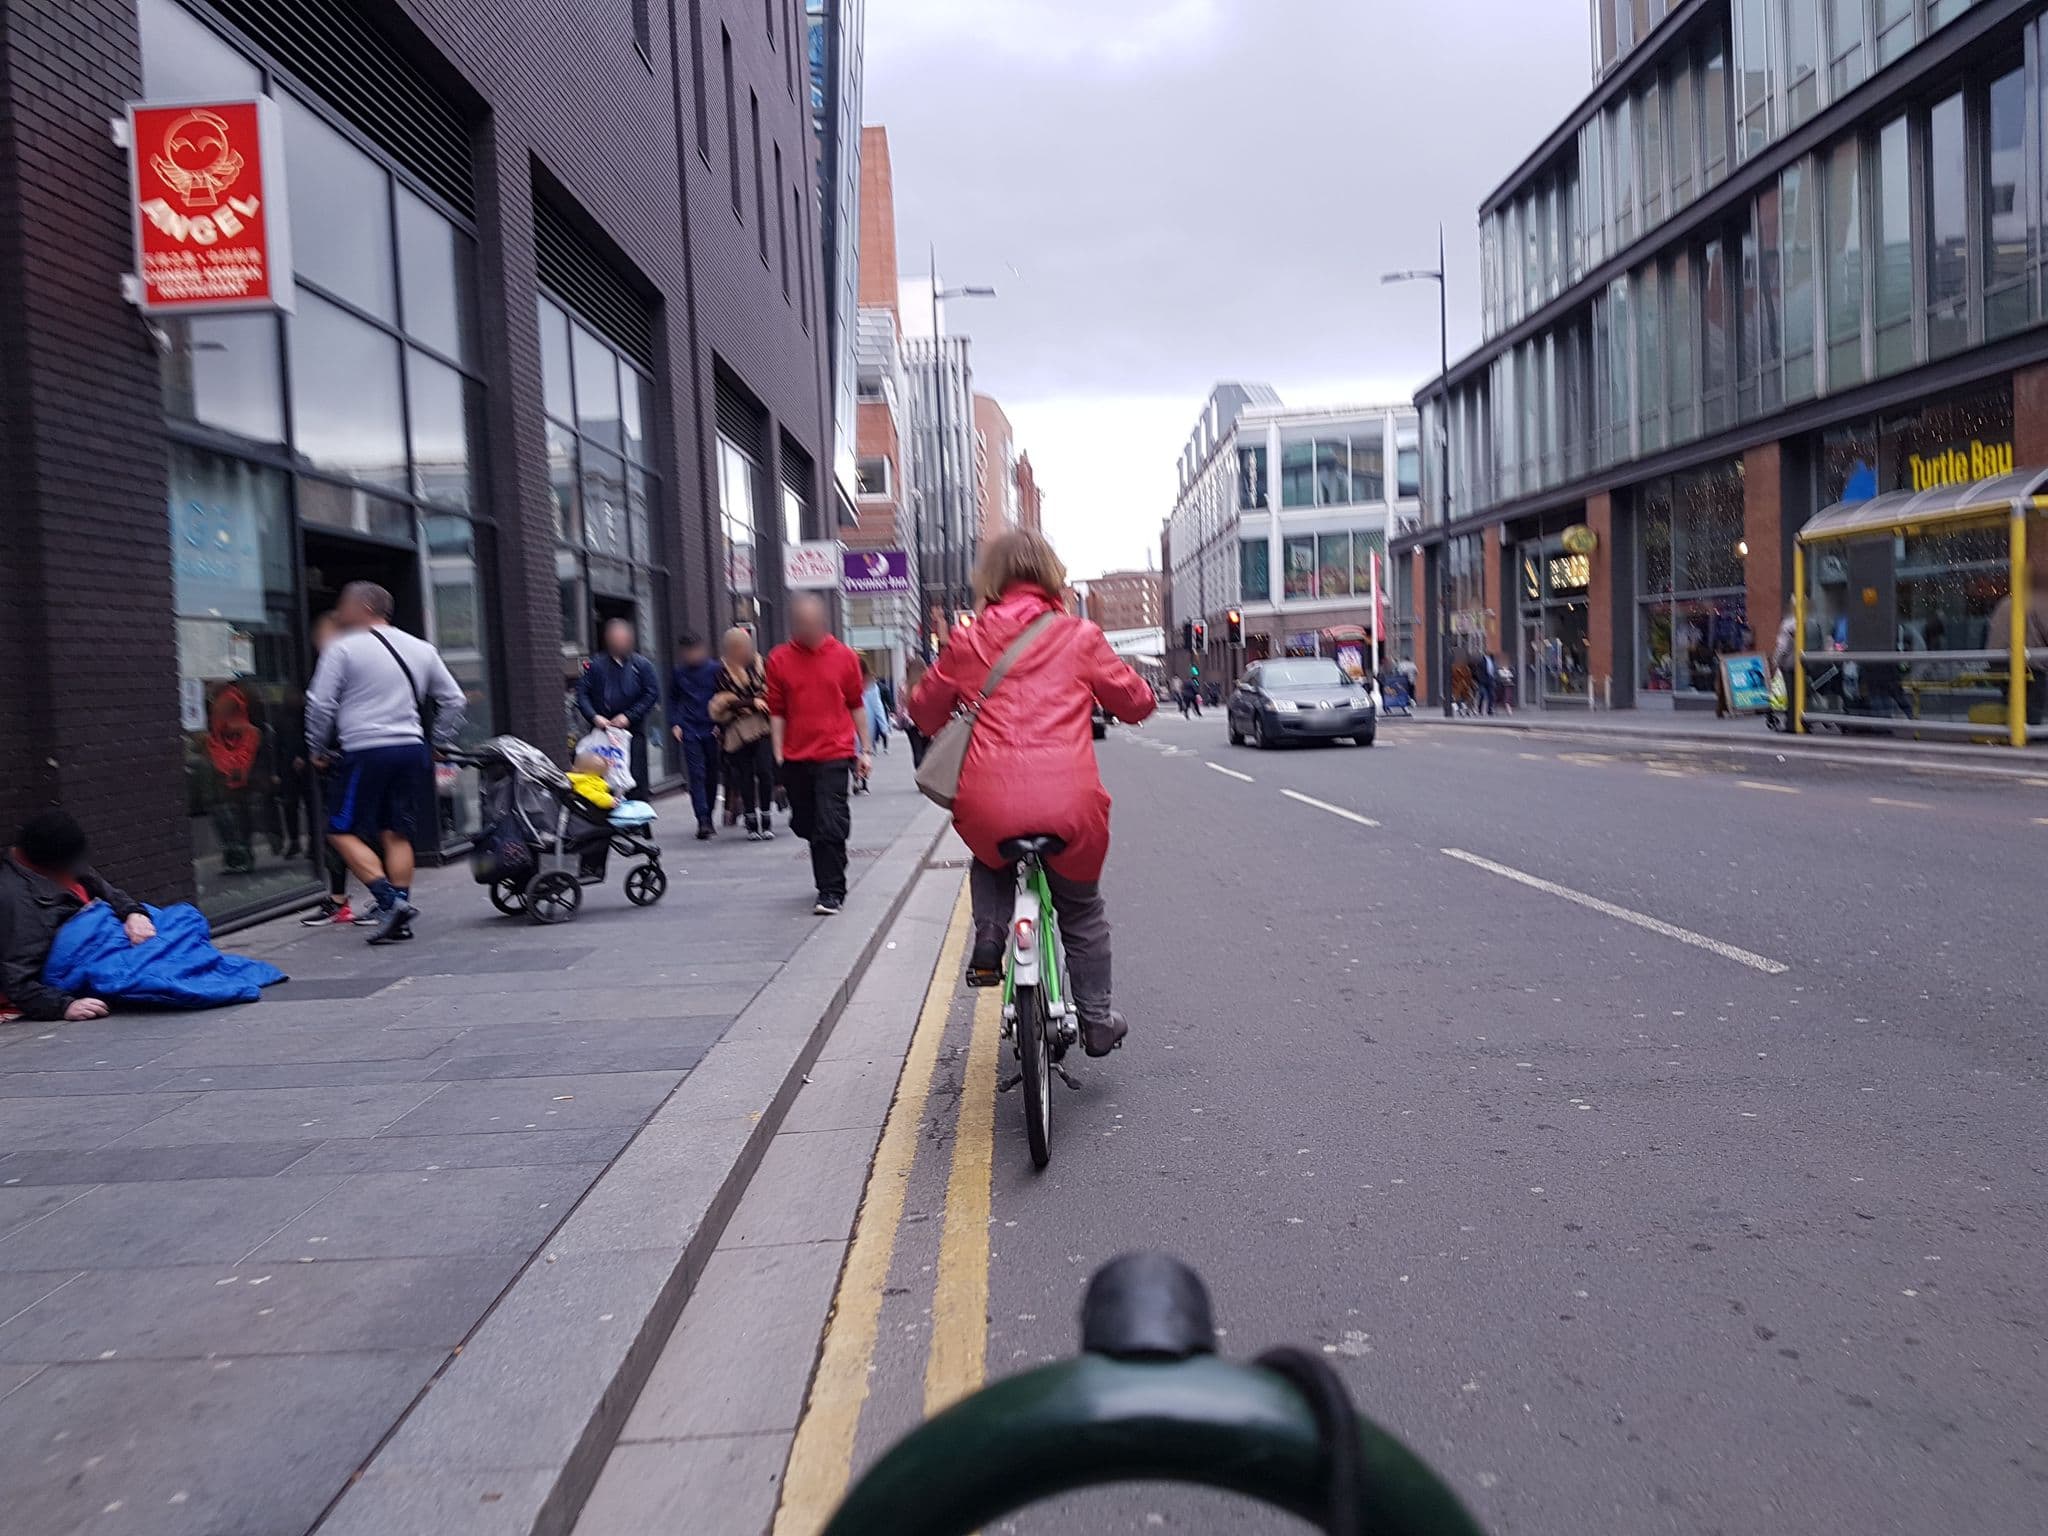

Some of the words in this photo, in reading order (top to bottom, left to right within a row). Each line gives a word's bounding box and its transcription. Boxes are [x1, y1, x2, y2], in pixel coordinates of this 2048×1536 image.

[1910, 448, 1968, 492] Turtle
[1971, 439, 2014, 482] Bay
[887, 574, 909, 591] Inn
